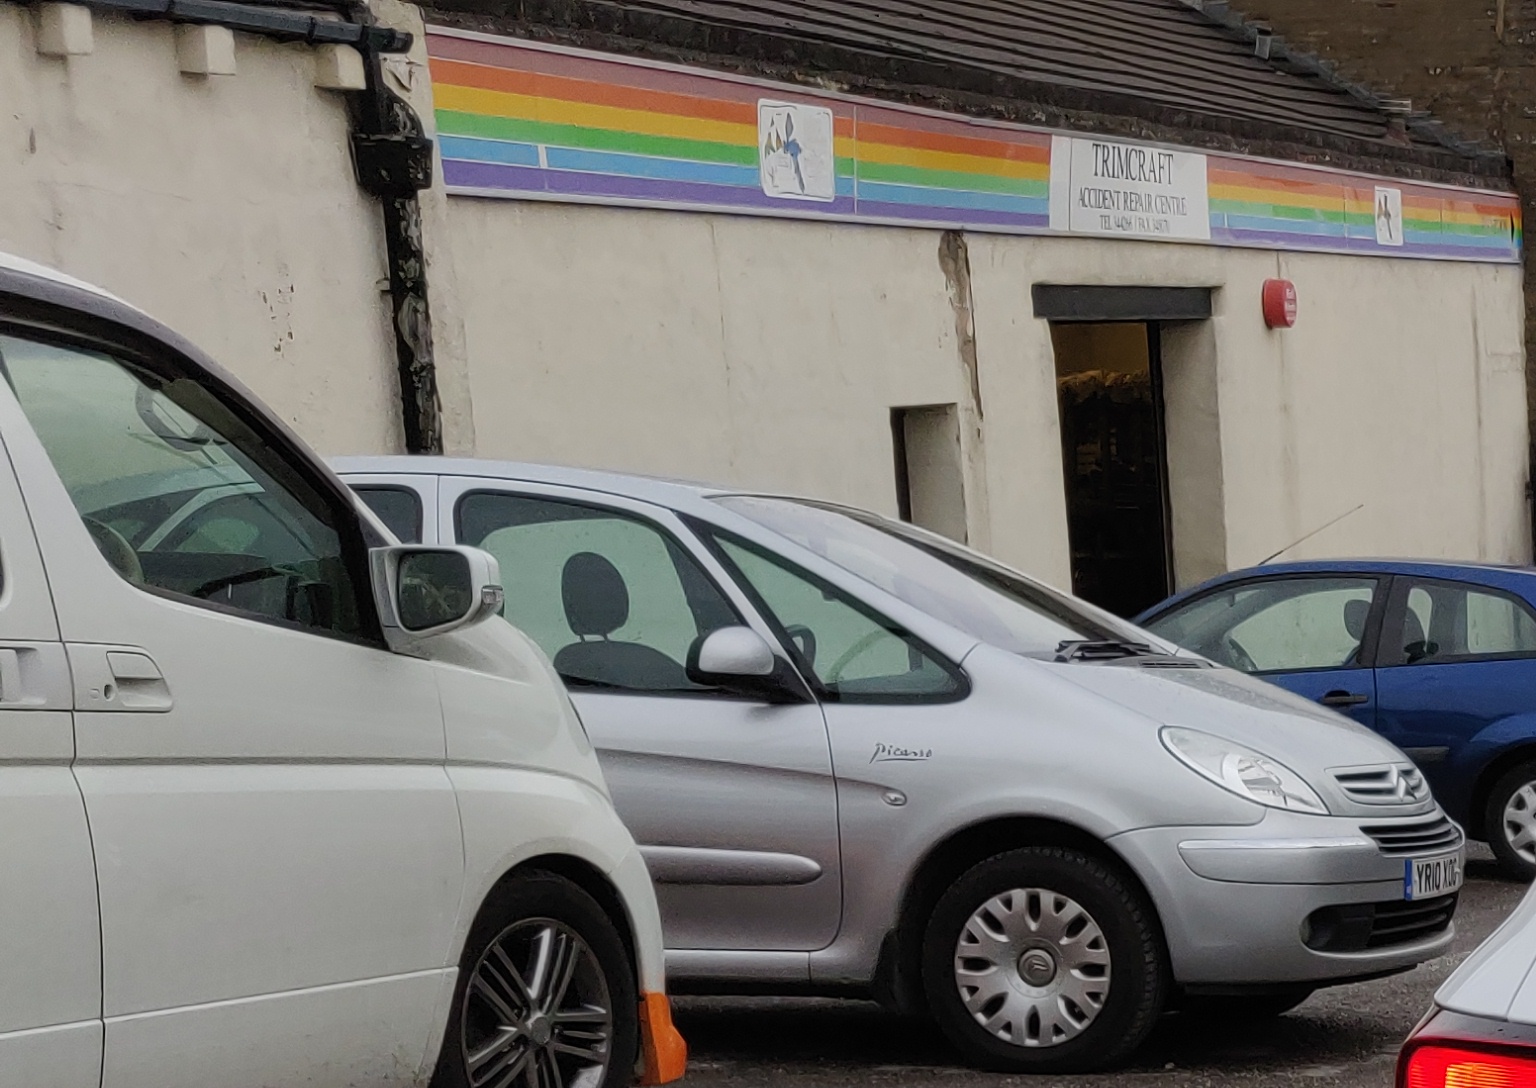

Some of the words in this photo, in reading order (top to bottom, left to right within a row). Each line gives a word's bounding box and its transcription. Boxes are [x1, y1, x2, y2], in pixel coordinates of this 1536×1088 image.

[1092, 142, 1173, 185] TRIMCRAFT
[1079, 187, 1121, 211] ACCIDENT
[1123, 191, 1154, 214] REPAIR
[1154, 195, 1187, 216] CENTRE
[869, 742, 932, 764] Picasso
[1417, 862, 1441, 893] YR10
